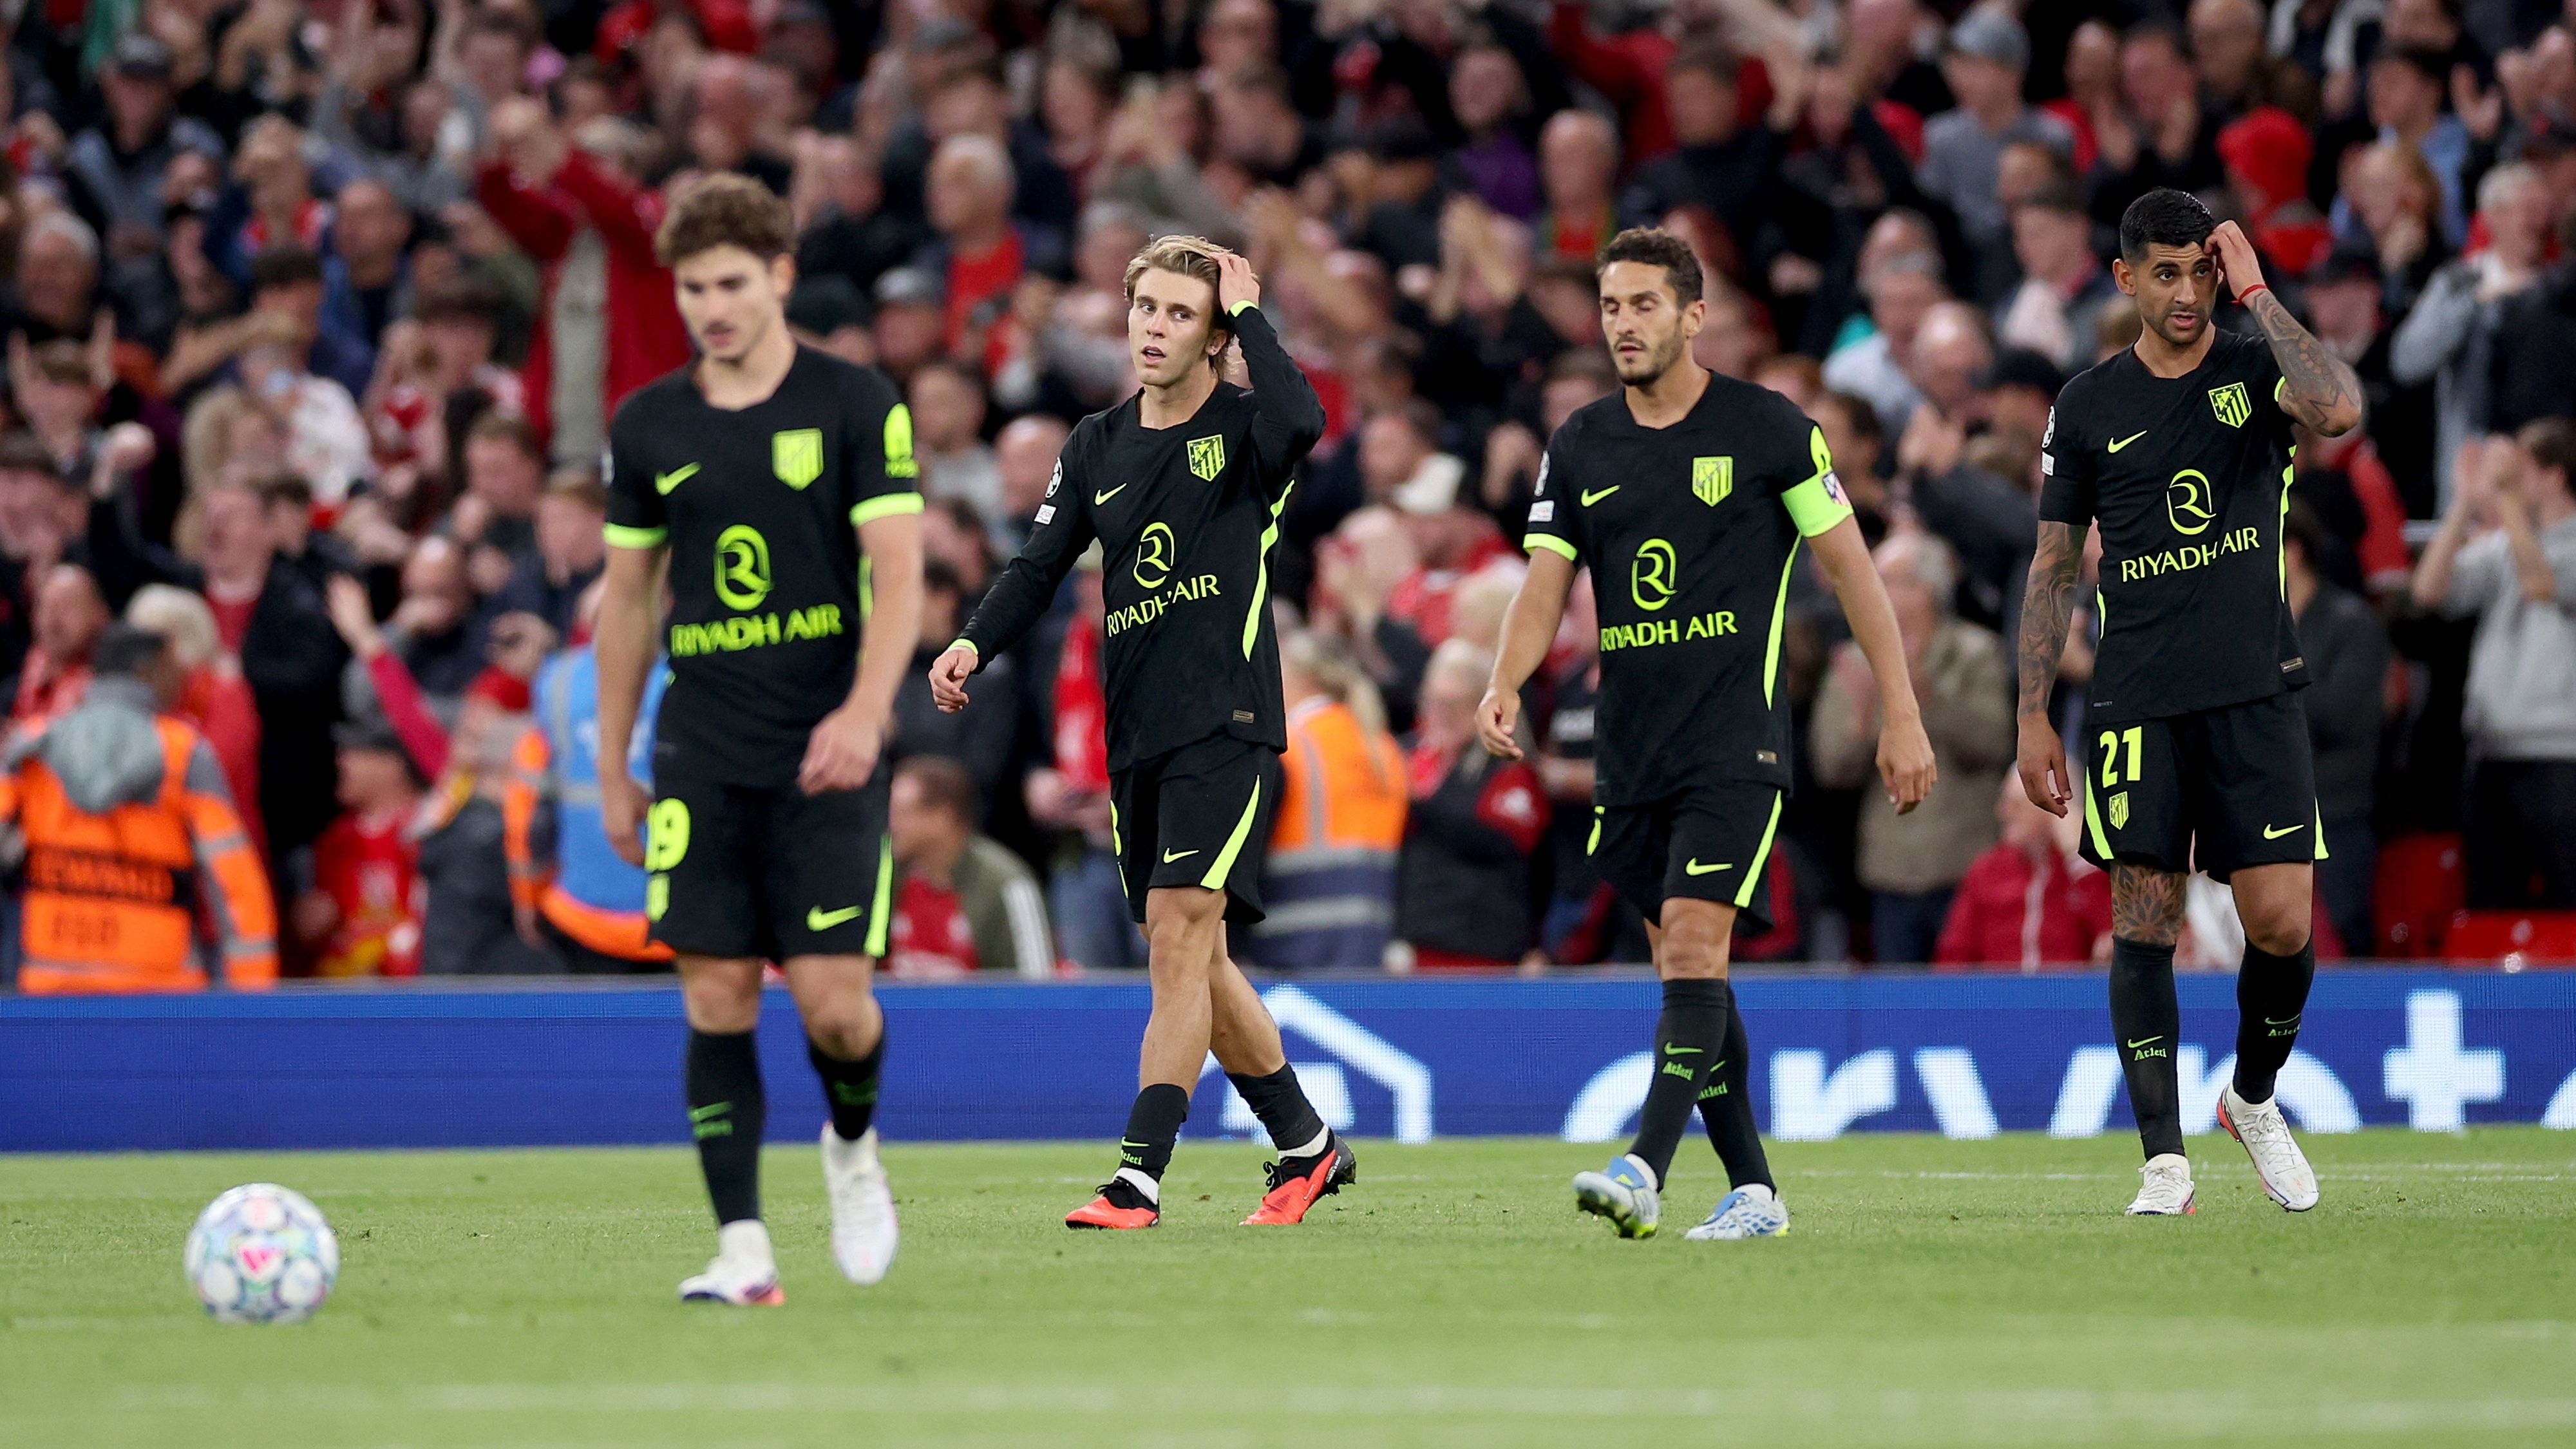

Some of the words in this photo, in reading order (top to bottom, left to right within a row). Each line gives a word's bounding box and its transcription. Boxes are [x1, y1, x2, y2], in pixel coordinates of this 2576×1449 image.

[2121, 541, 2218, 582] RIYADH
[2221, 527, 2260, 555] AIR
[1172, 574, 1221, 603] AIR
[782, 603, 843, 643] AIR
[1600, 619, 1679, 652] RIYADH
[1685, 611, 1738, 640] AIR
[2099, 726, 2142, 788] 21
[2134, 1046, 2167, 1061] Atleti
